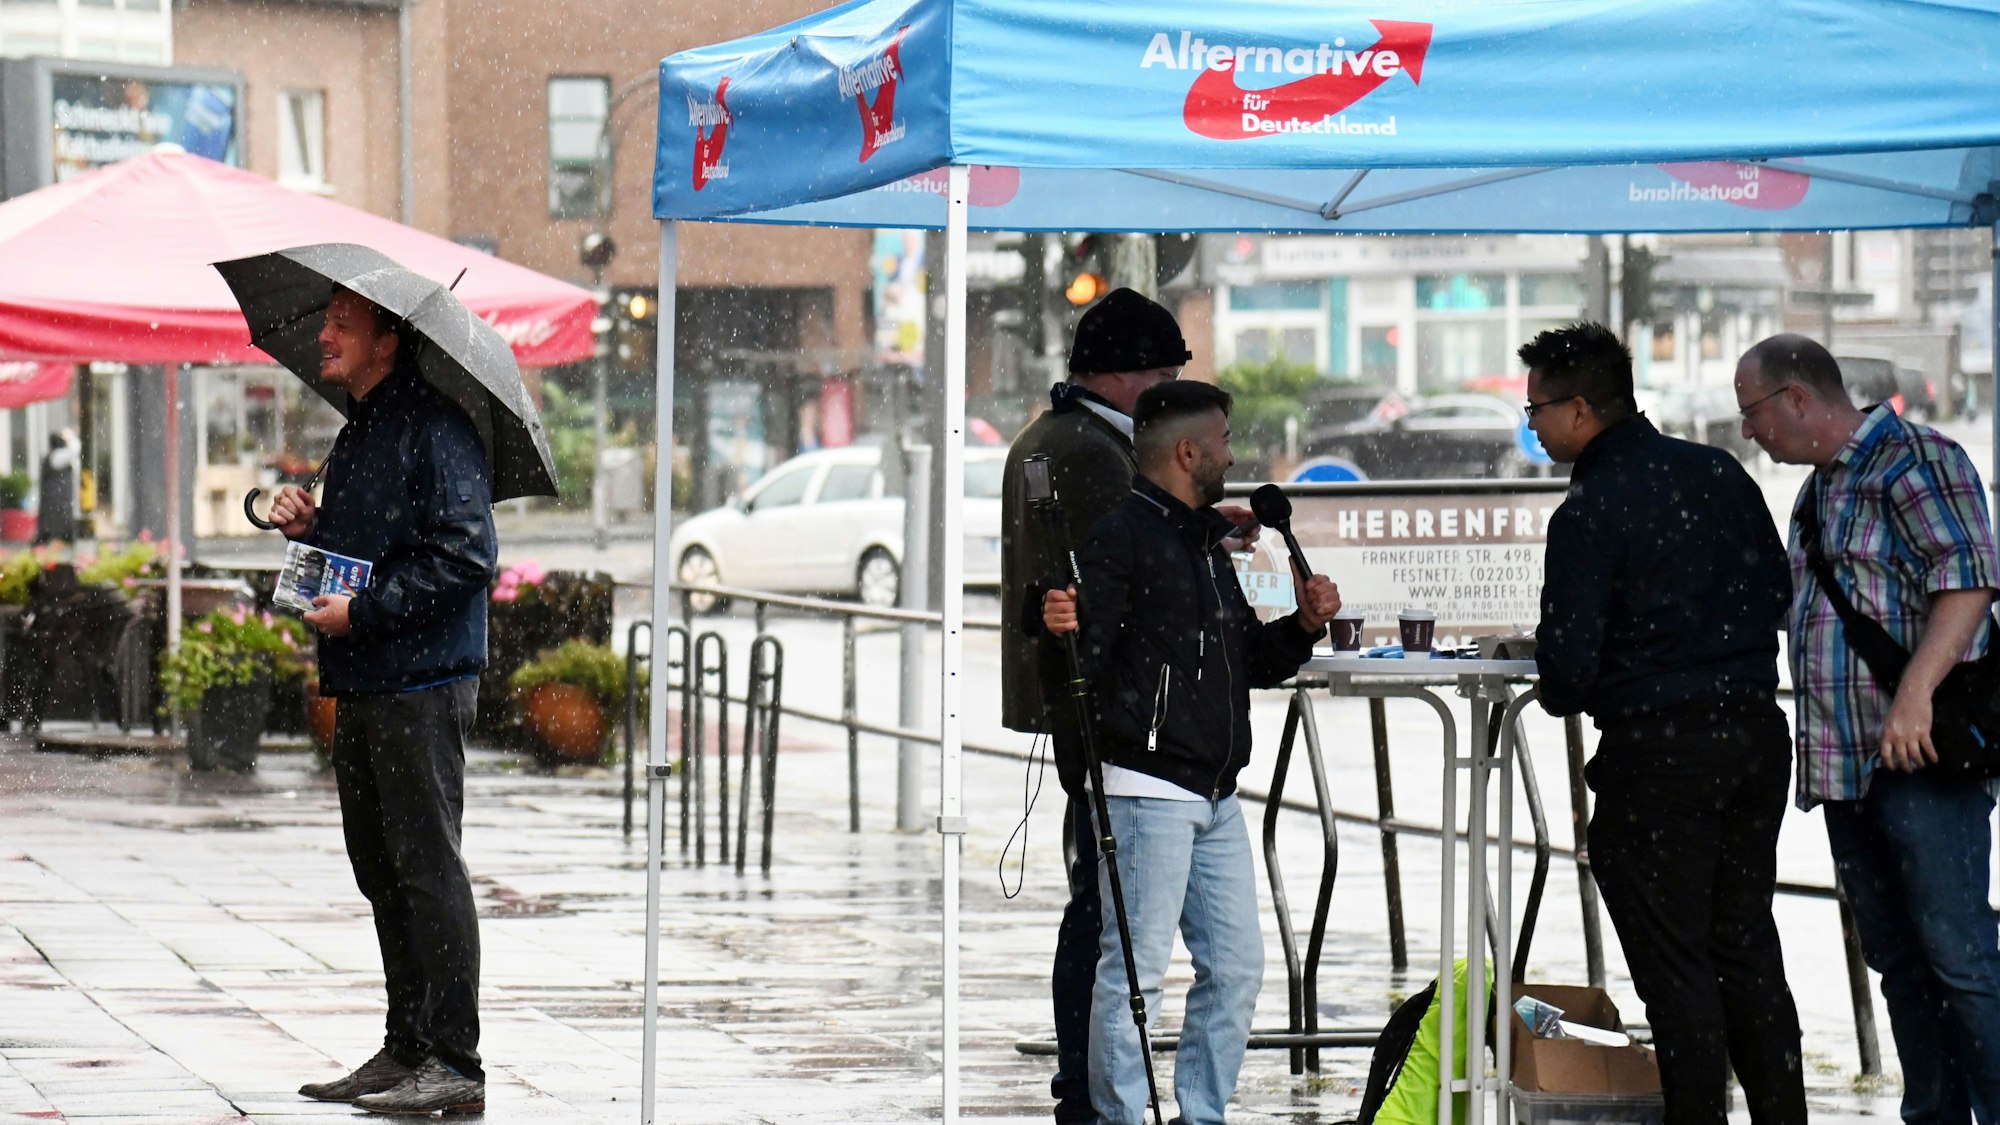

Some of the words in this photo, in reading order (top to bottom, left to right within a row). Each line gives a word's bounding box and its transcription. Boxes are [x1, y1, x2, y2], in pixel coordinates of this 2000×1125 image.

[1140, 31, 1399, 77] Alternative
[839, 54, 897, 100] Alternative
[687, 90, 730, 126] Alternative
[1243, 93, 1270, 111] für
[873, 117, 905, 149] Deutschland
[1242, 113, 1397, 136] Deutschland
[1362, 550, 1461, 565] FRANKFURTER
[1466, 549, 1496, 564] STR.
[1504, 549, 1538, 564] 498,
[1393, 568, 1463, 583] FESTNETZ:
[1470, 567, 1530, 582] (02203)
